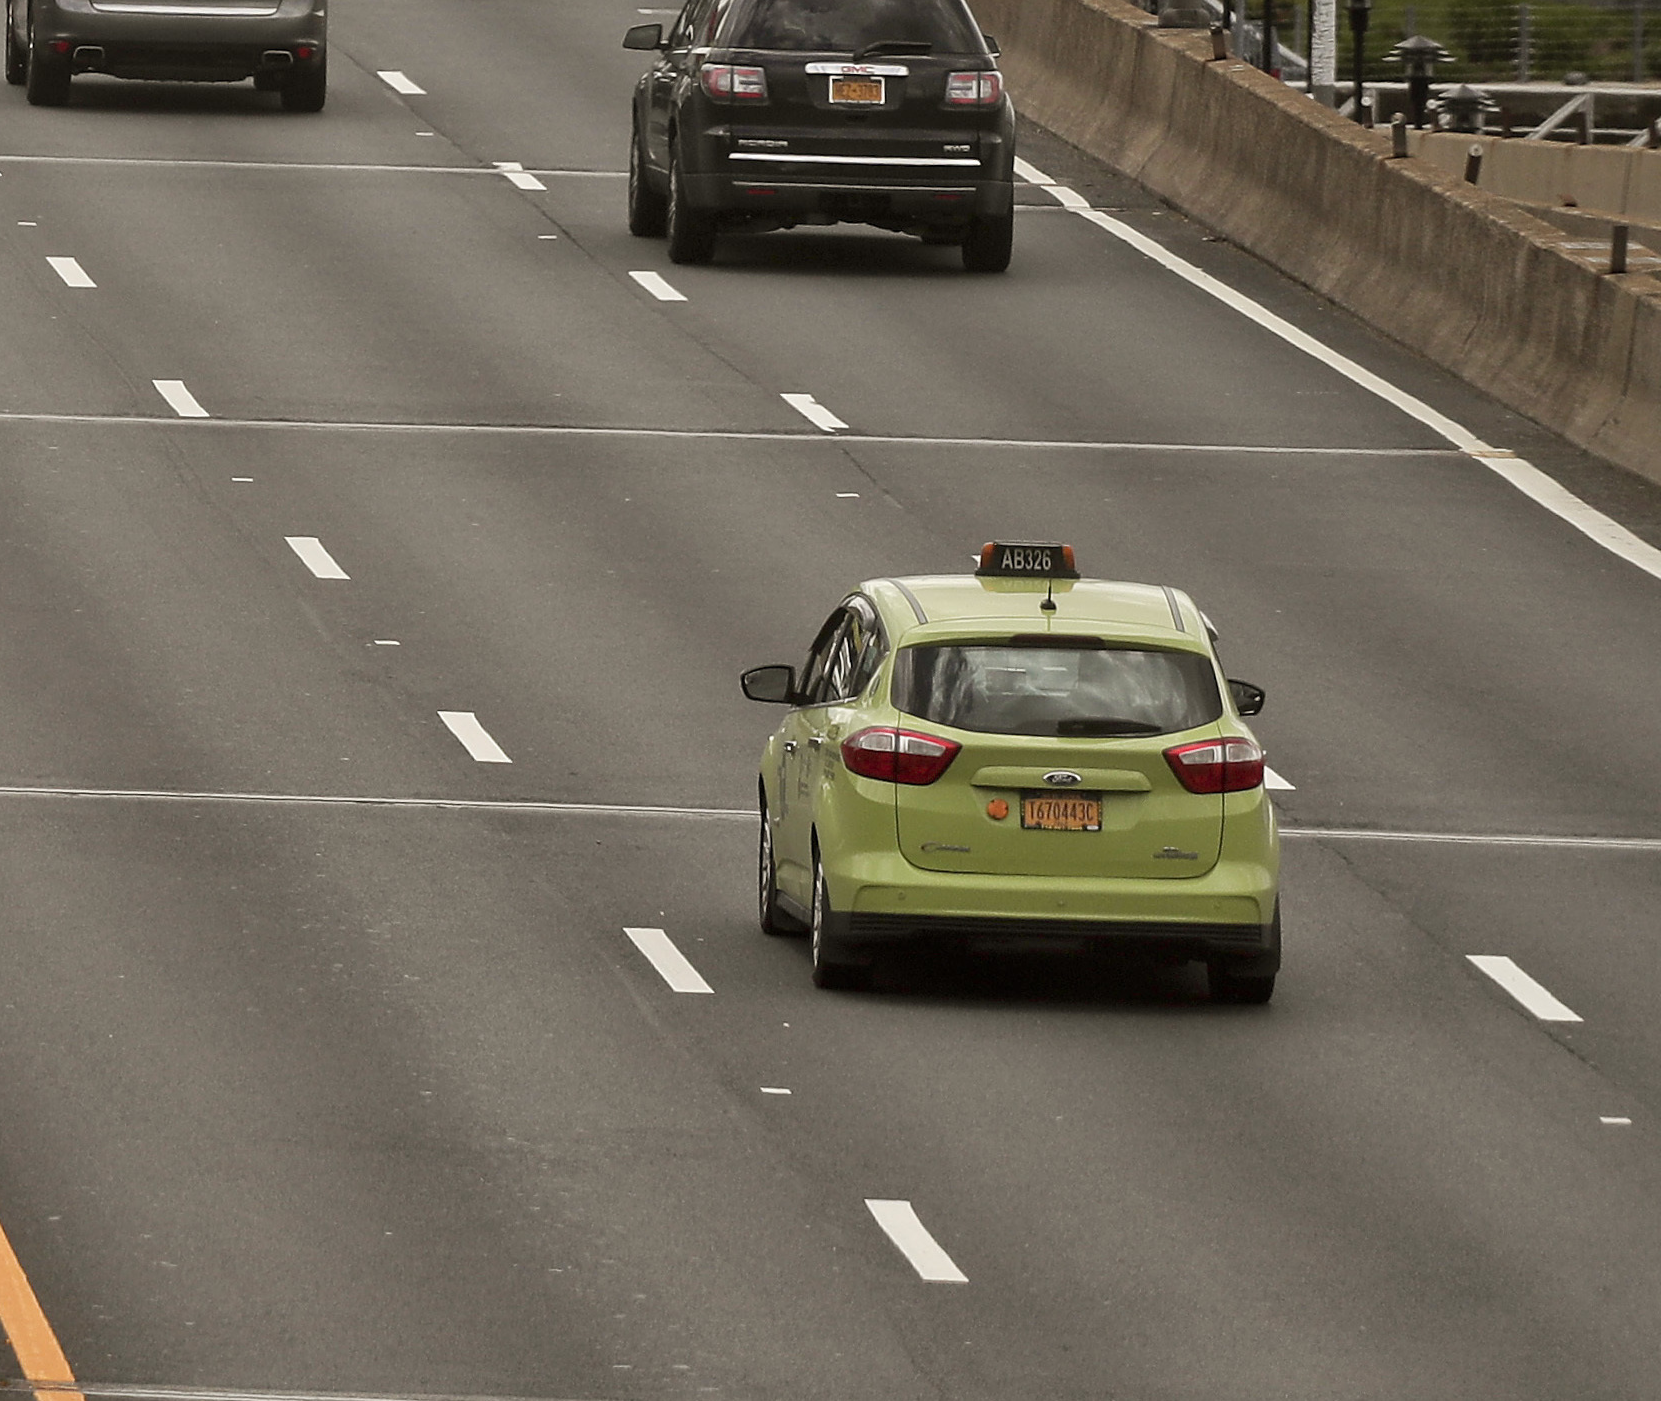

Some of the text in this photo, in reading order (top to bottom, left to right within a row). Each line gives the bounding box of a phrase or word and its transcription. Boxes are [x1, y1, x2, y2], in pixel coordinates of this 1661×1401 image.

[841, 65, 876, 75] GMC
[1000, 548, 1052, 571] AB326
[1027, 801, 1094, 822] T670443C
